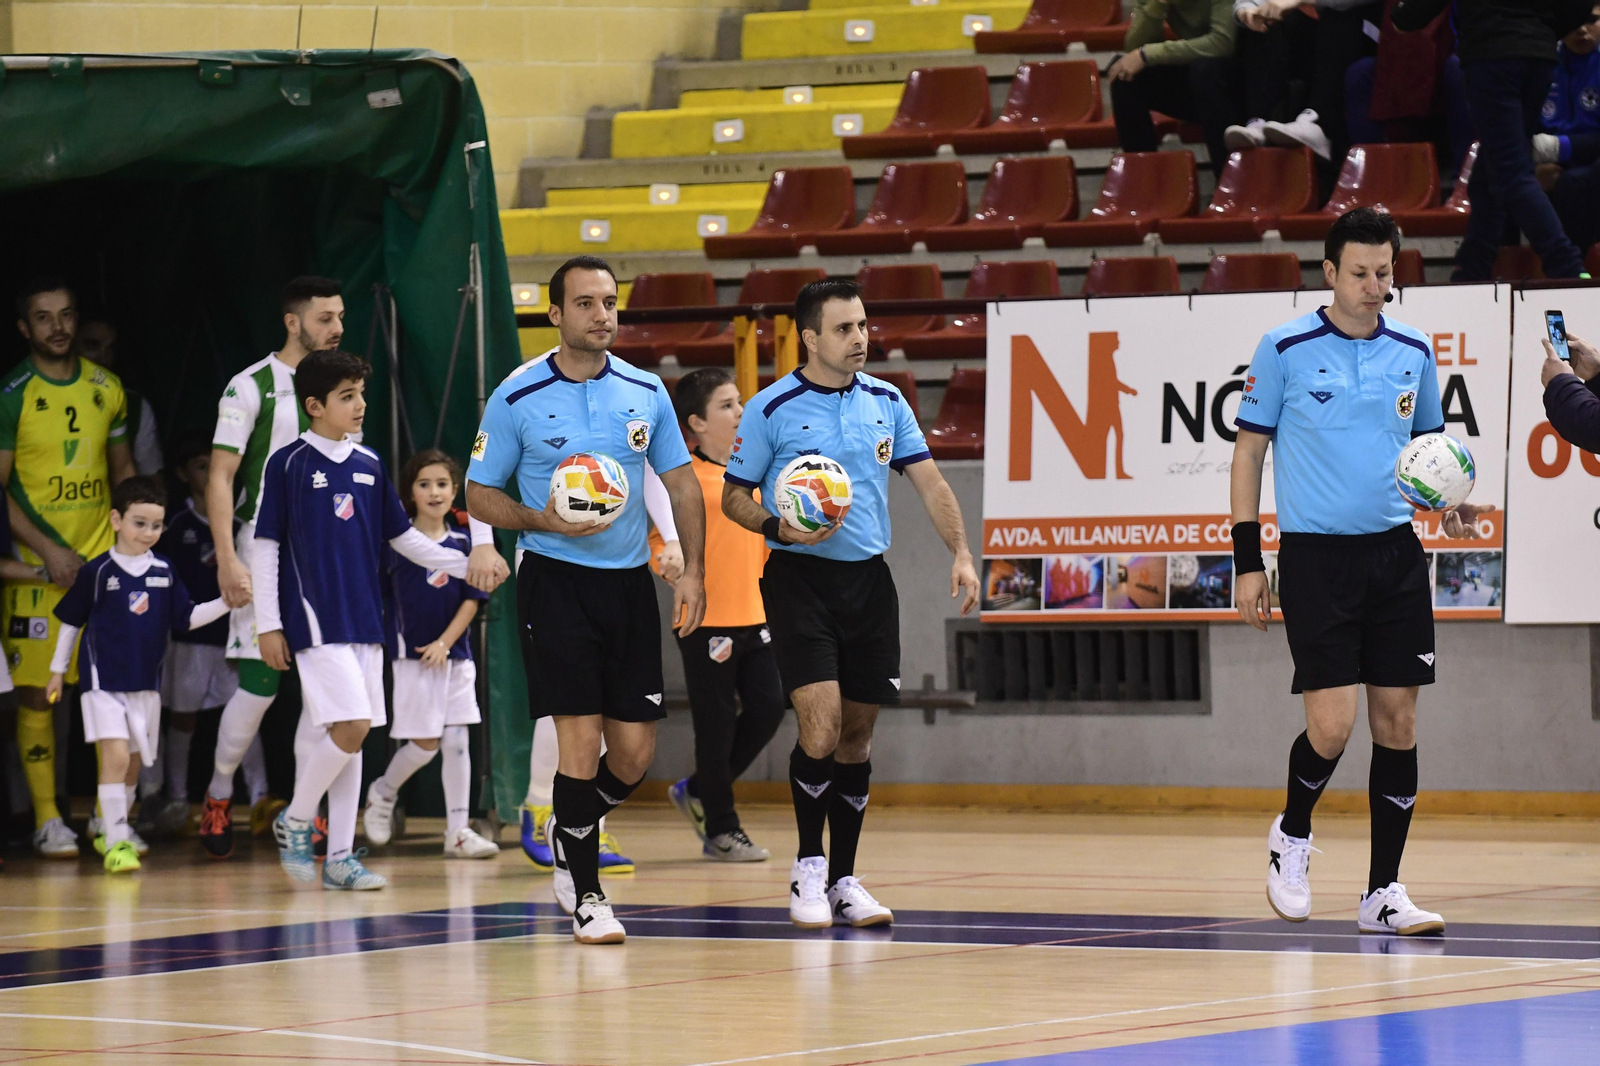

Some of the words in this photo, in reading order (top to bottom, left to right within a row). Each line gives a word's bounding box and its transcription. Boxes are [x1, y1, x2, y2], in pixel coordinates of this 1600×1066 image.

[66, 406, 80, 433] 2
[48, 473, 103, 503] Jaén
[989, 527, 1047, 547] AVDA.
[1051, 524, 1169, 546] VILLANUEVA
[1173, 524, 1200, 544] DE
